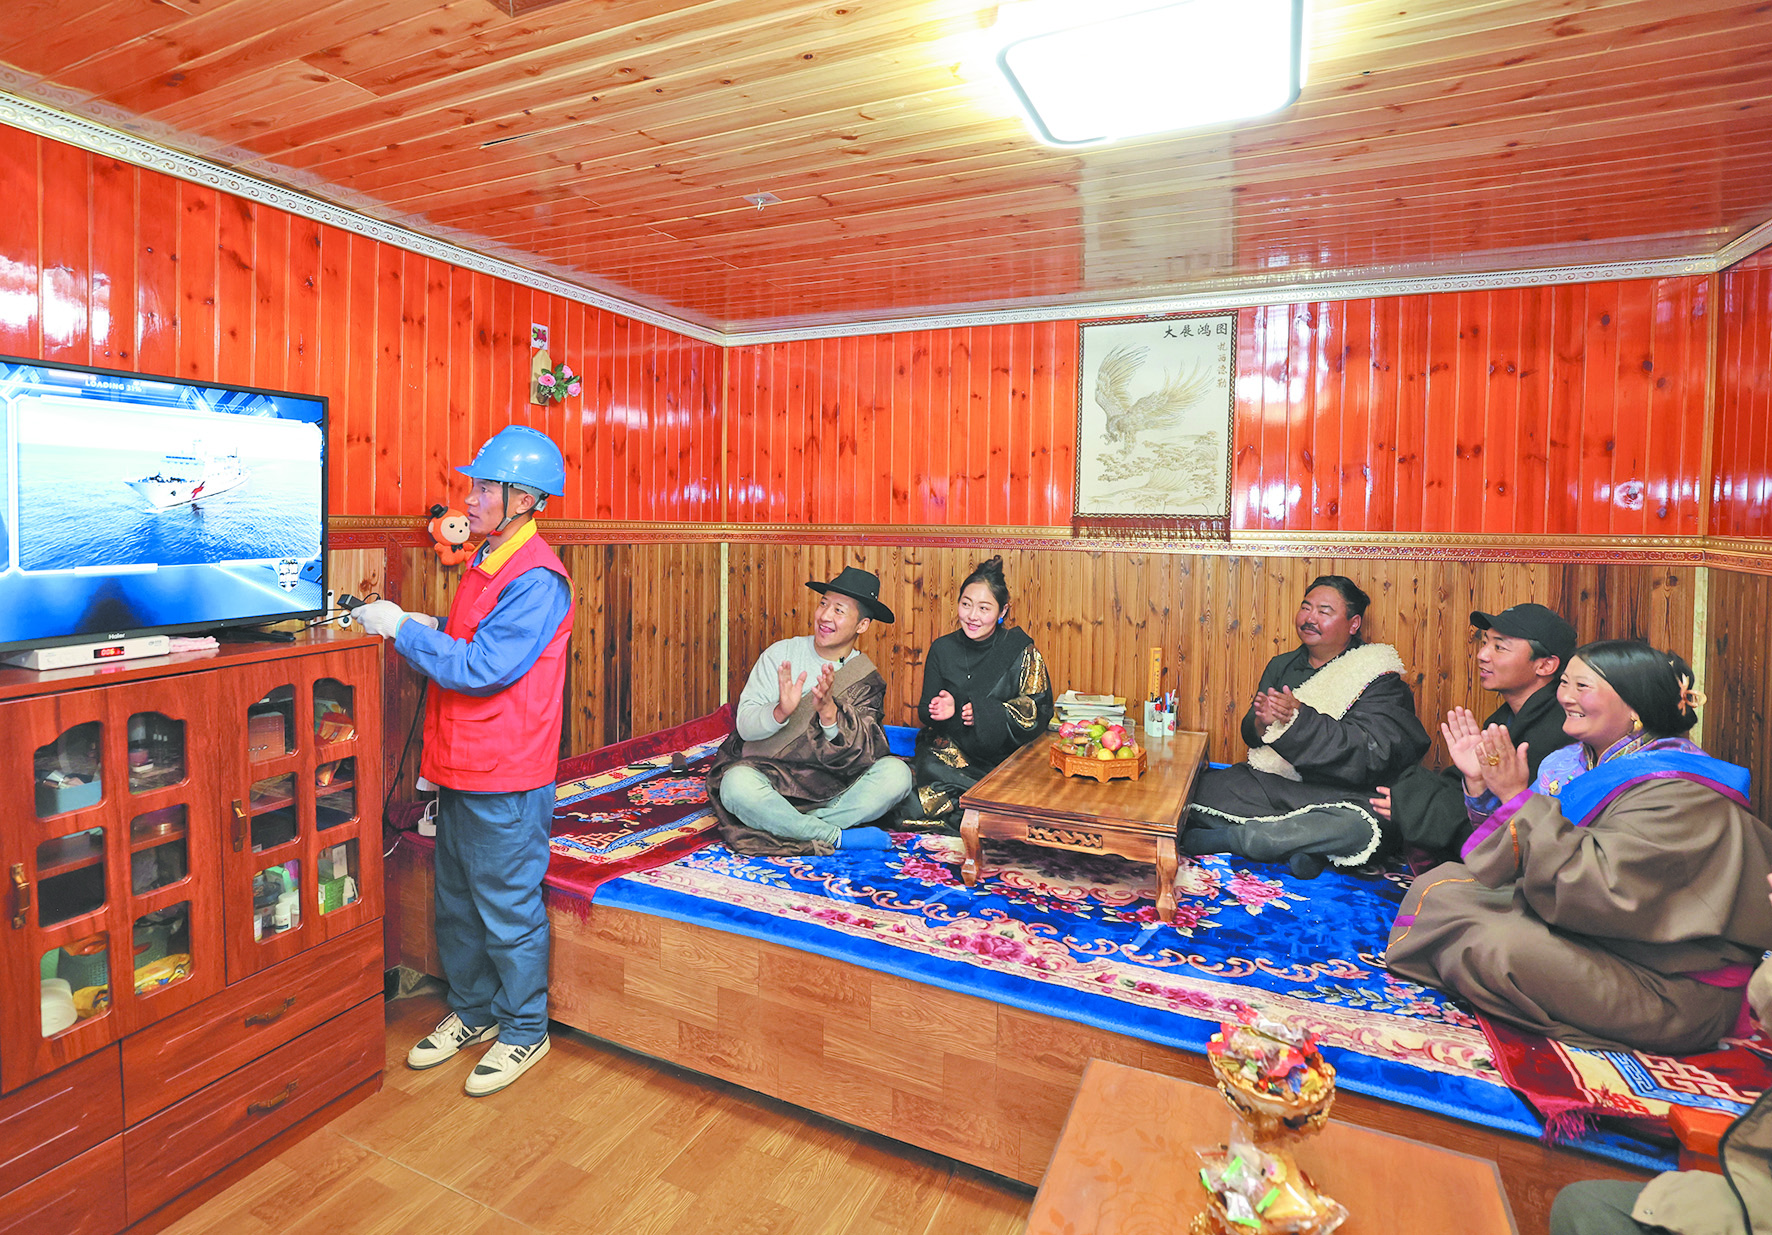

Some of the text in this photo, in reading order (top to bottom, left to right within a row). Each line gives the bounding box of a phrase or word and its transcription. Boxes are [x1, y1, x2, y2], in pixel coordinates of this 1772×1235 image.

[1163, 323, 1228, 338] 大展鸿图
[85, 380, 124, 390] LOADING
